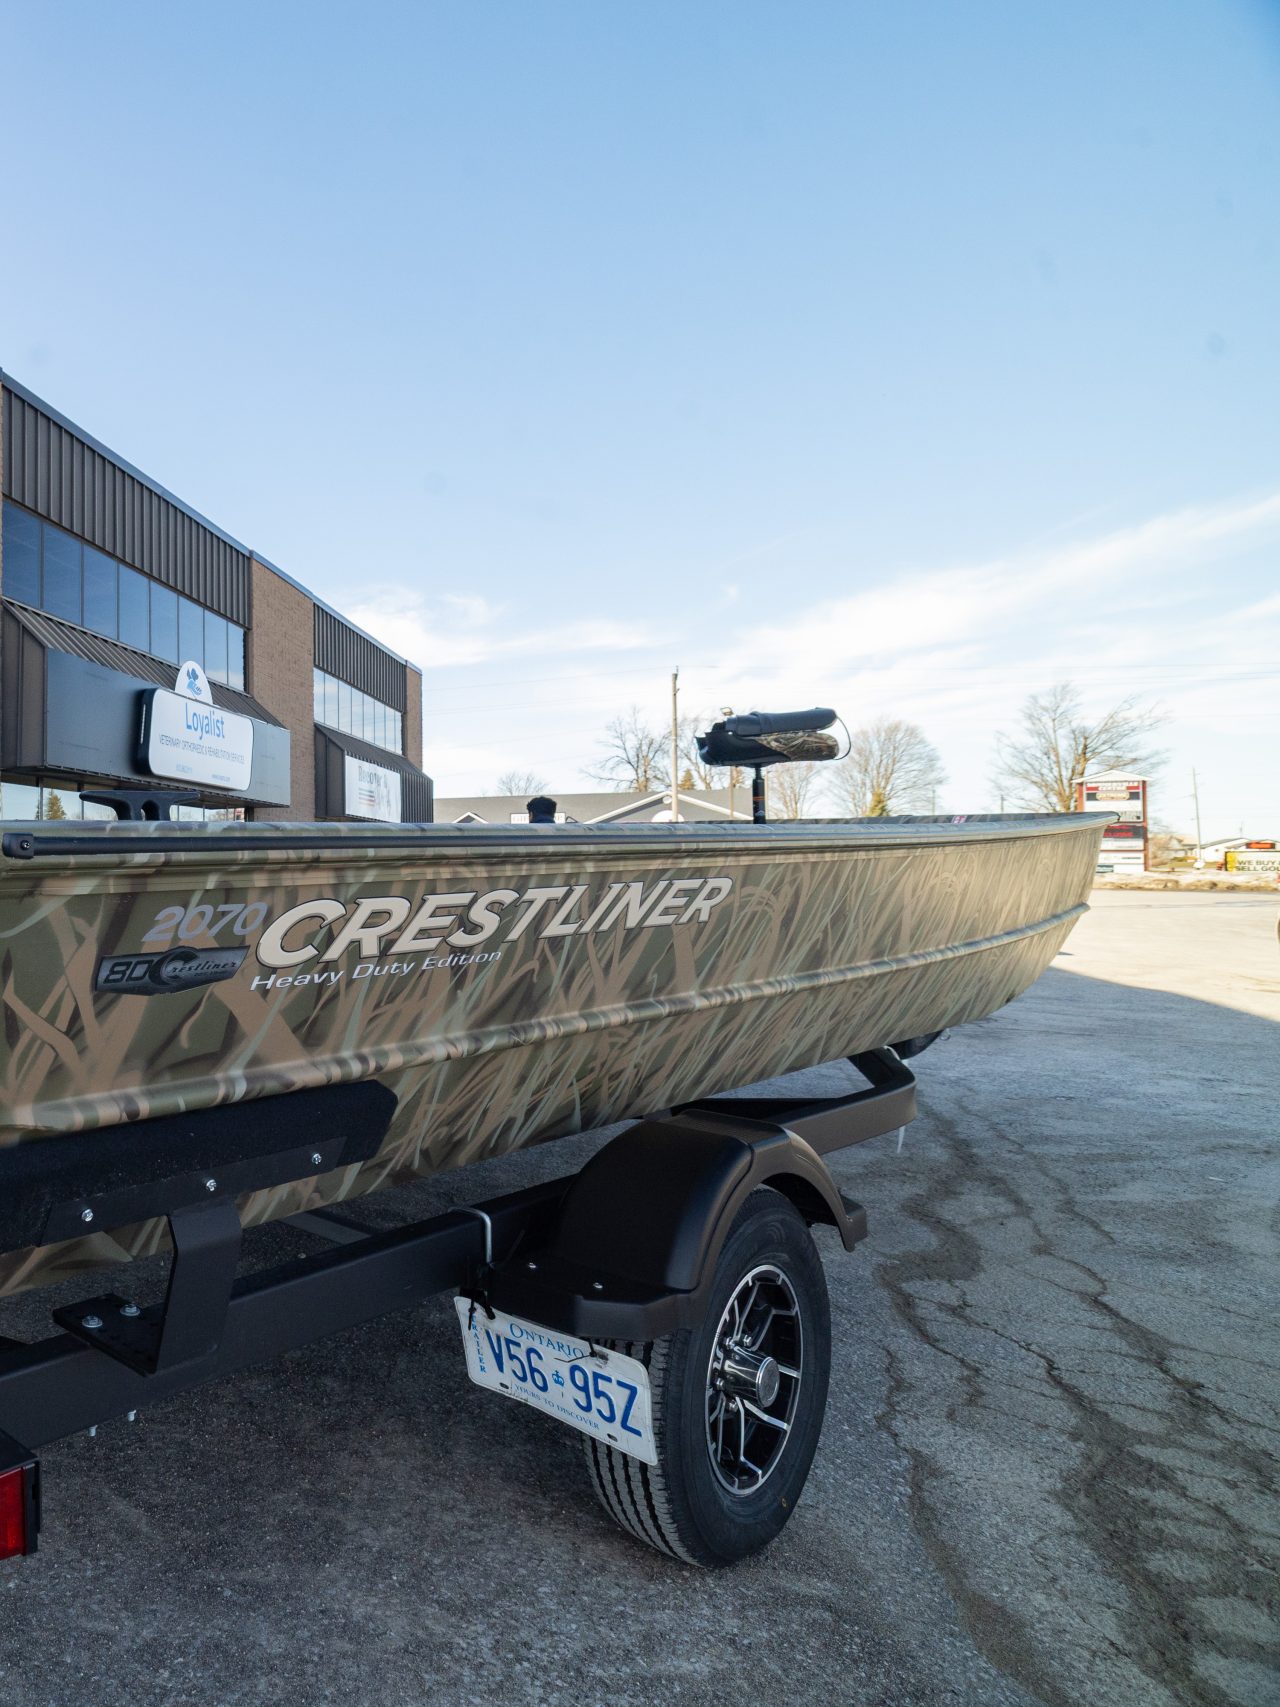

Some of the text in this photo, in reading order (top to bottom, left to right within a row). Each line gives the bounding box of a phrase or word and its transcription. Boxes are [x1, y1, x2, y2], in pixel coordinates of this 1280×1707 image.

[185, 702, 225, 740] Loyalist
[141, 902, 268, 942] 2070
[256, 877, 733, 969] CRESTLINER
[250, 948, 502, 993] Heavy Duty Edition
[509, 1322, 584, 1359] ONTARIO
[485, 1328, 643, 1438] V56 95Z
[514, 1383, 600, 1430] YOURS TO DISCOVER
